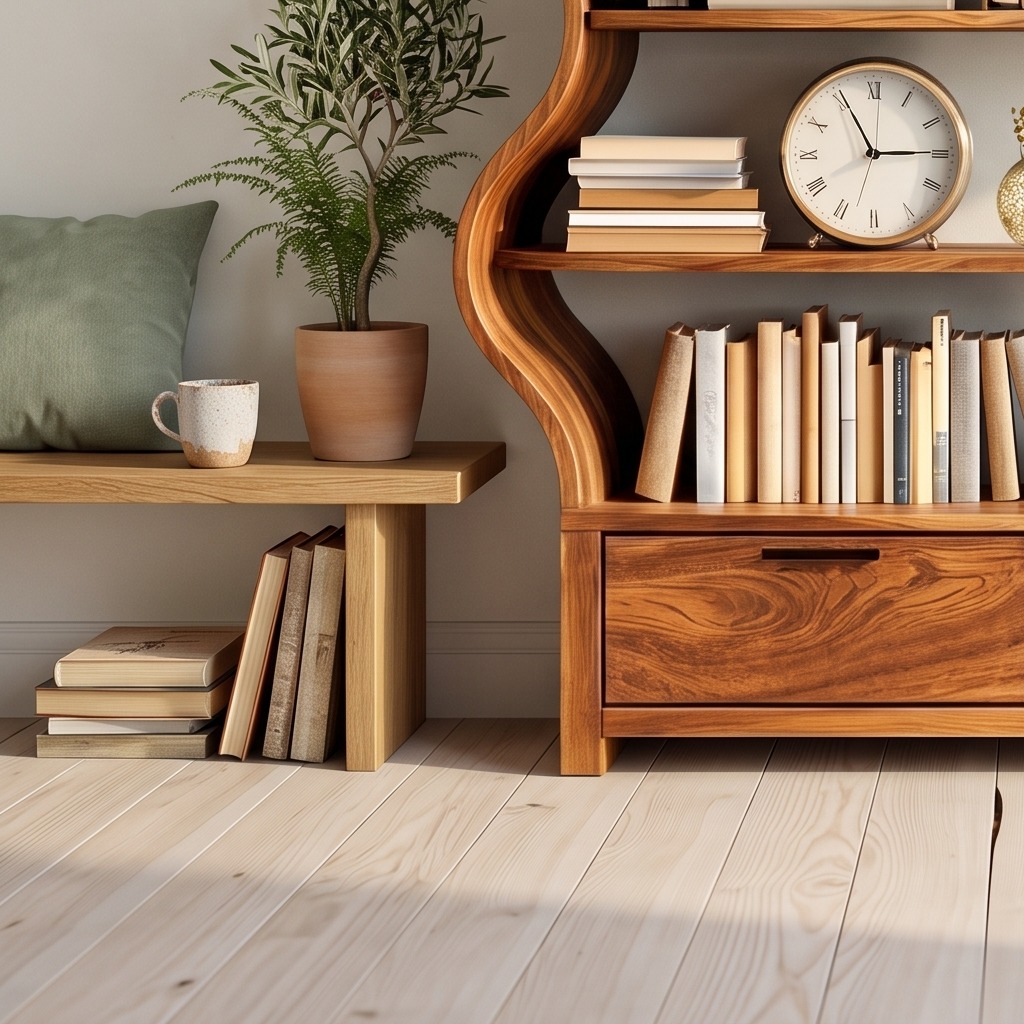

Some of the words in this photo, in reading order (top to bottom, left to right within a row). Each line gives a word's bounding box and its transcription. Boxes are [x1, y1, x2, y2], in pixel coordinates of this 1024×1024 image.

[807, 117, 828, 133] X
[922, 117, 941, 130] II
[931, 150, 949, 158] III
